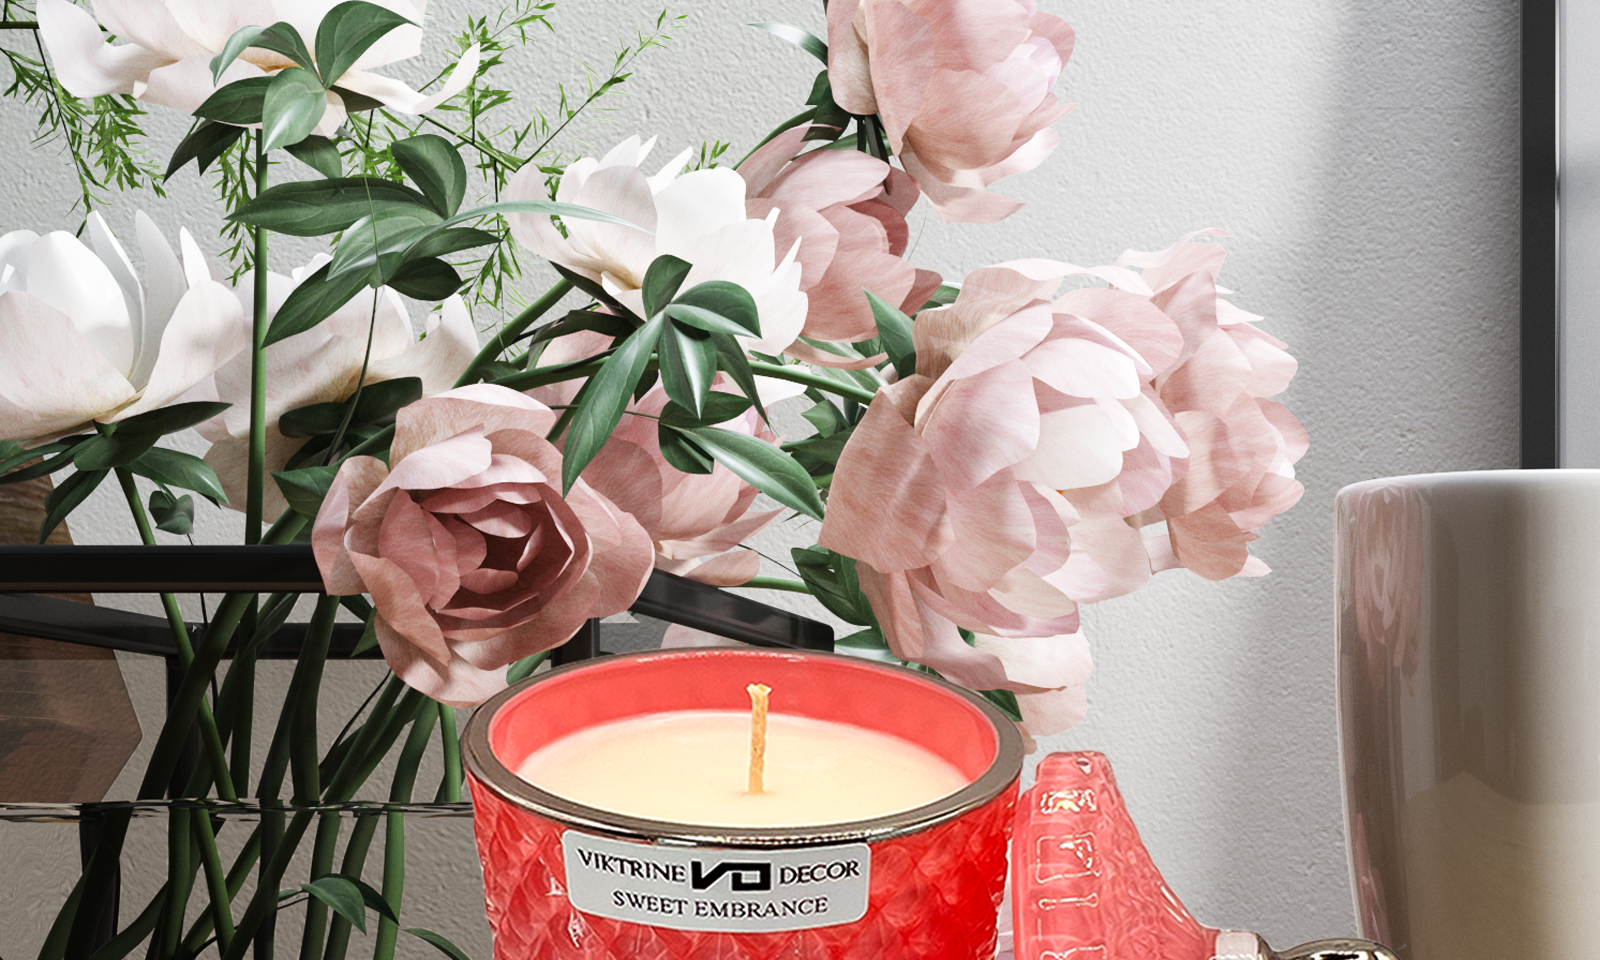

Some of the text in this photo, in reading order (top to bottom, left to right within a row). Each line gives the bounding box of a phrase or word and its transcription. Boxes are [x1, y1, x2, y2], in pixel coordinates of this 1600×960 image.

[578, 849, 686, 882] VIKTRINE
[779, 860, 860, 884] DECOR
[613, 891, 828, 918] SWEET EMBRANCE
